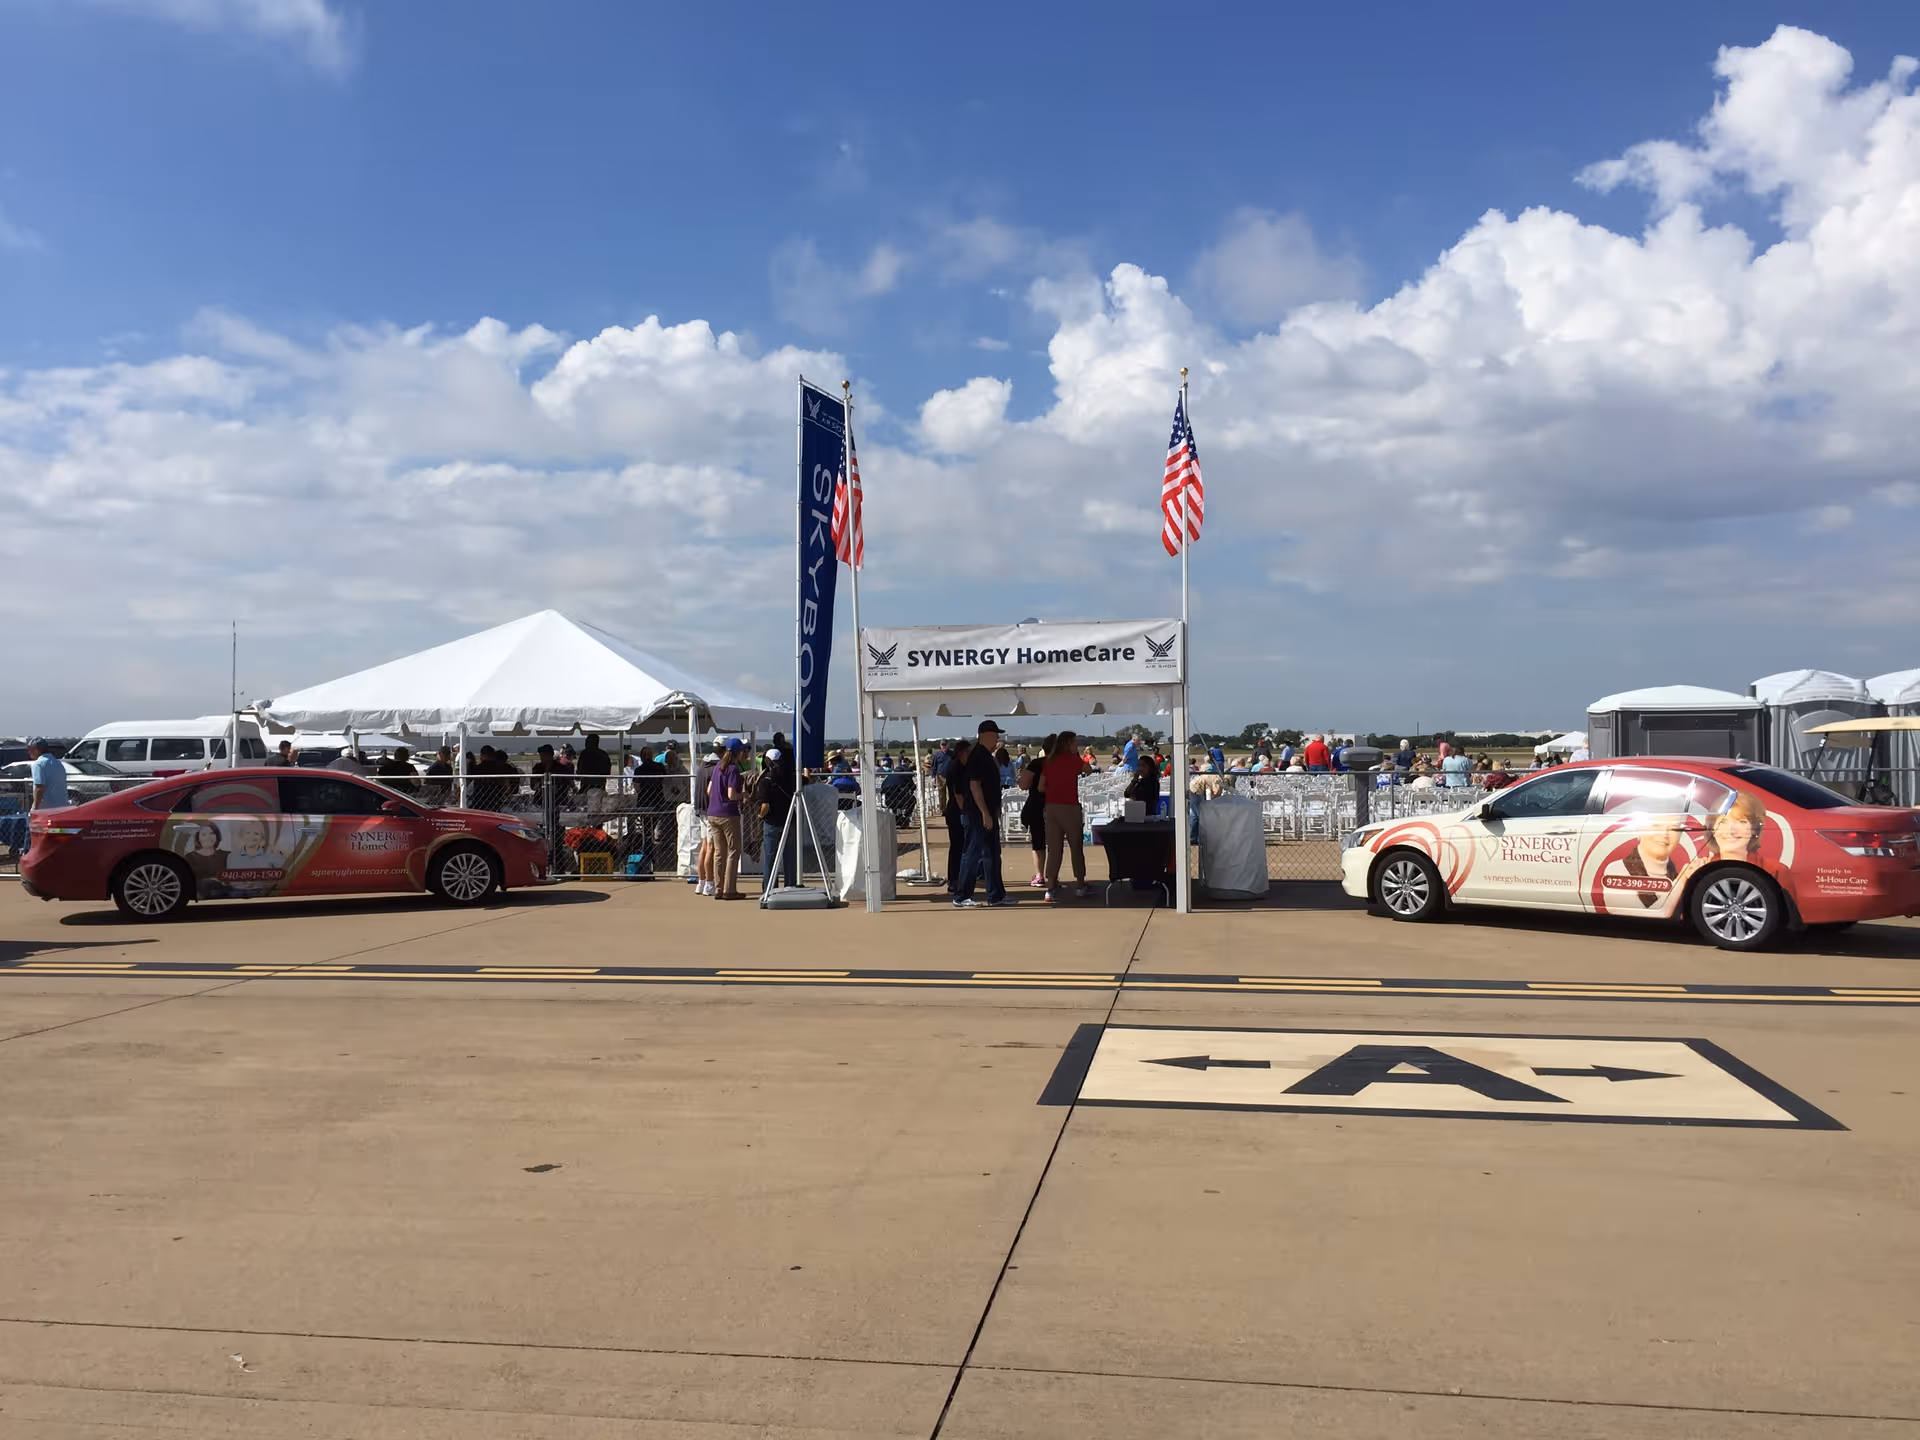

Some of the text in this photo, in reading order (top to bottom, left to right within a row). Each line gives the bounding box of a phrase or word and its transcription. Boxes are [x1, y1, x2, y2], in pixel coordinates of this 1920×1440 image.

[907, 645, 1135, 667] SYNERGY HomeCare
[350, 831, 409, 841] SYNERGY
[351, 841, 410, 851] HomeCare
[1501, 836, 1572, 851] SYNERGY
[1502, 849, 1572, 864] HomeCare
[221, 870, 283, 880] 940-891-1500
[311, 867, 409, 877] synergyhomecare.com
[1817, 867, 1841, 875] Hourly
[1483, 874, 1572, 887] synergyhomecare.com
[1606, 877, 1669, 890] 972-390-7579
[1815, 875, 1869, 884] 24-Hour Care
[1280, 1045, 1573, 1103] A
